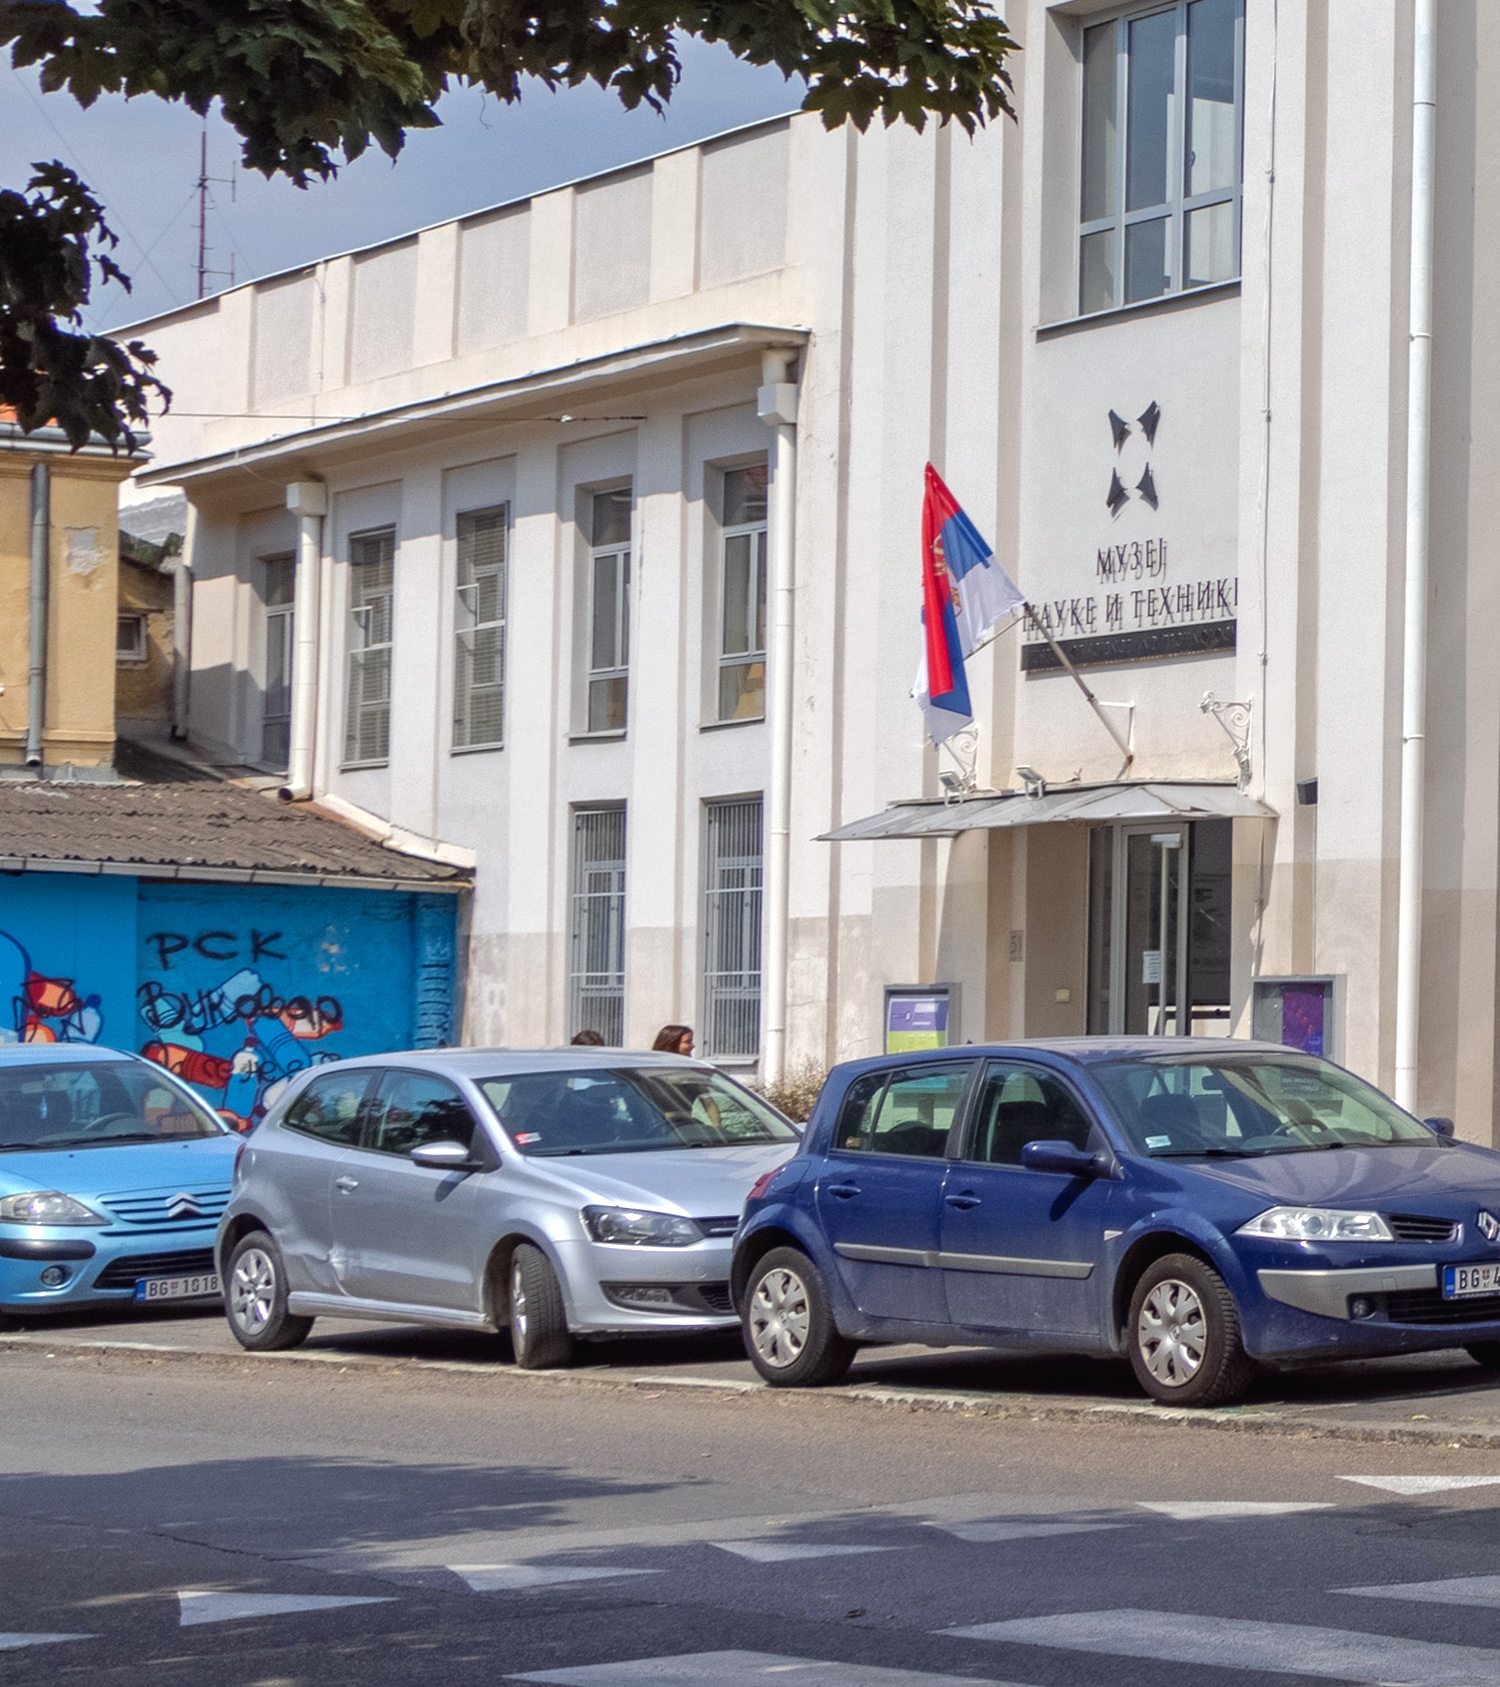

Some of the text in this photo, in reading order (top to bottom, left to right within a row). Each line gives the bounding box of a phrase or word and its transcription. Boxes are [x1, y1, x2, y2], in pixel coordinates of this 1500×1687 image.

[1095, 537, 1166, 577] МУЗЕЈ
[1021, 596, 1096, 633] НАУКЕ
[1105, 592, 1121, 624] И
[149, 1281, 169, 1298] BG
[1459, 1268, 1480, 1290] BG
